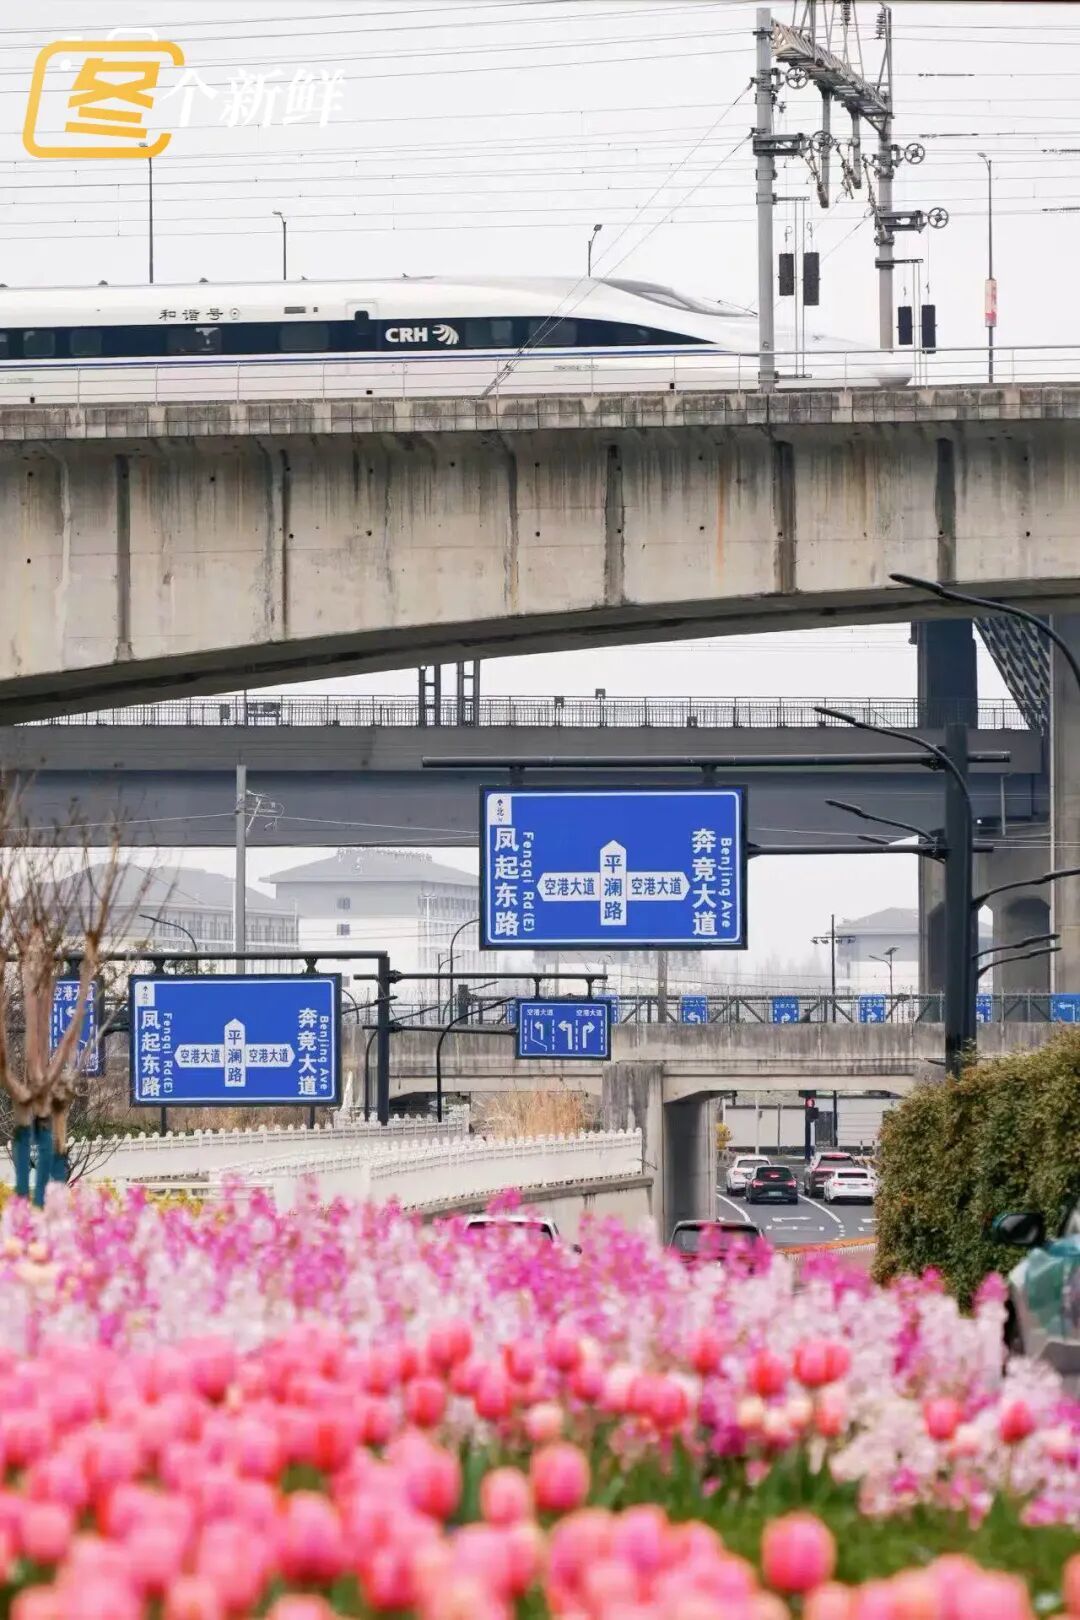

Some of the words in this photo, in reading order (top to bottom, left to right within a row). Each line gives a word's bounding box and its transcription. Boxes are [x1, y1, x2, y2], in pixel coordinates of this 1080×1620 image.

[158, 308, 223, 321] 和谐号
[385, 327, 428, 343] CRH
[520, 831, 535, 883] Fengqi
[717, 837, 733, 896] Benjing
[494, 827, 520, 936] 凤起东路
[544, 877, 595, 896] 空港大道
[604, 854, 623, 920] 平澜路
[631, 876, 682, 895] 空港大道
[691, 828, 718, 936] 奔竞大道
[721, 900, 733, 928] Ave
[141, 1010, 161, 1097] 凤起东路
[161, 1012, 173, 1054] Fengqi
[317, 1015, 329, 1063] Benjing
[180, 1049, 221, 1064] 空港大道
[228, 1030, 242, 1082] 平澜路
[249, 1048, 289, 1063] 空港大道
[320, 1068, 329, 1090] Ave
